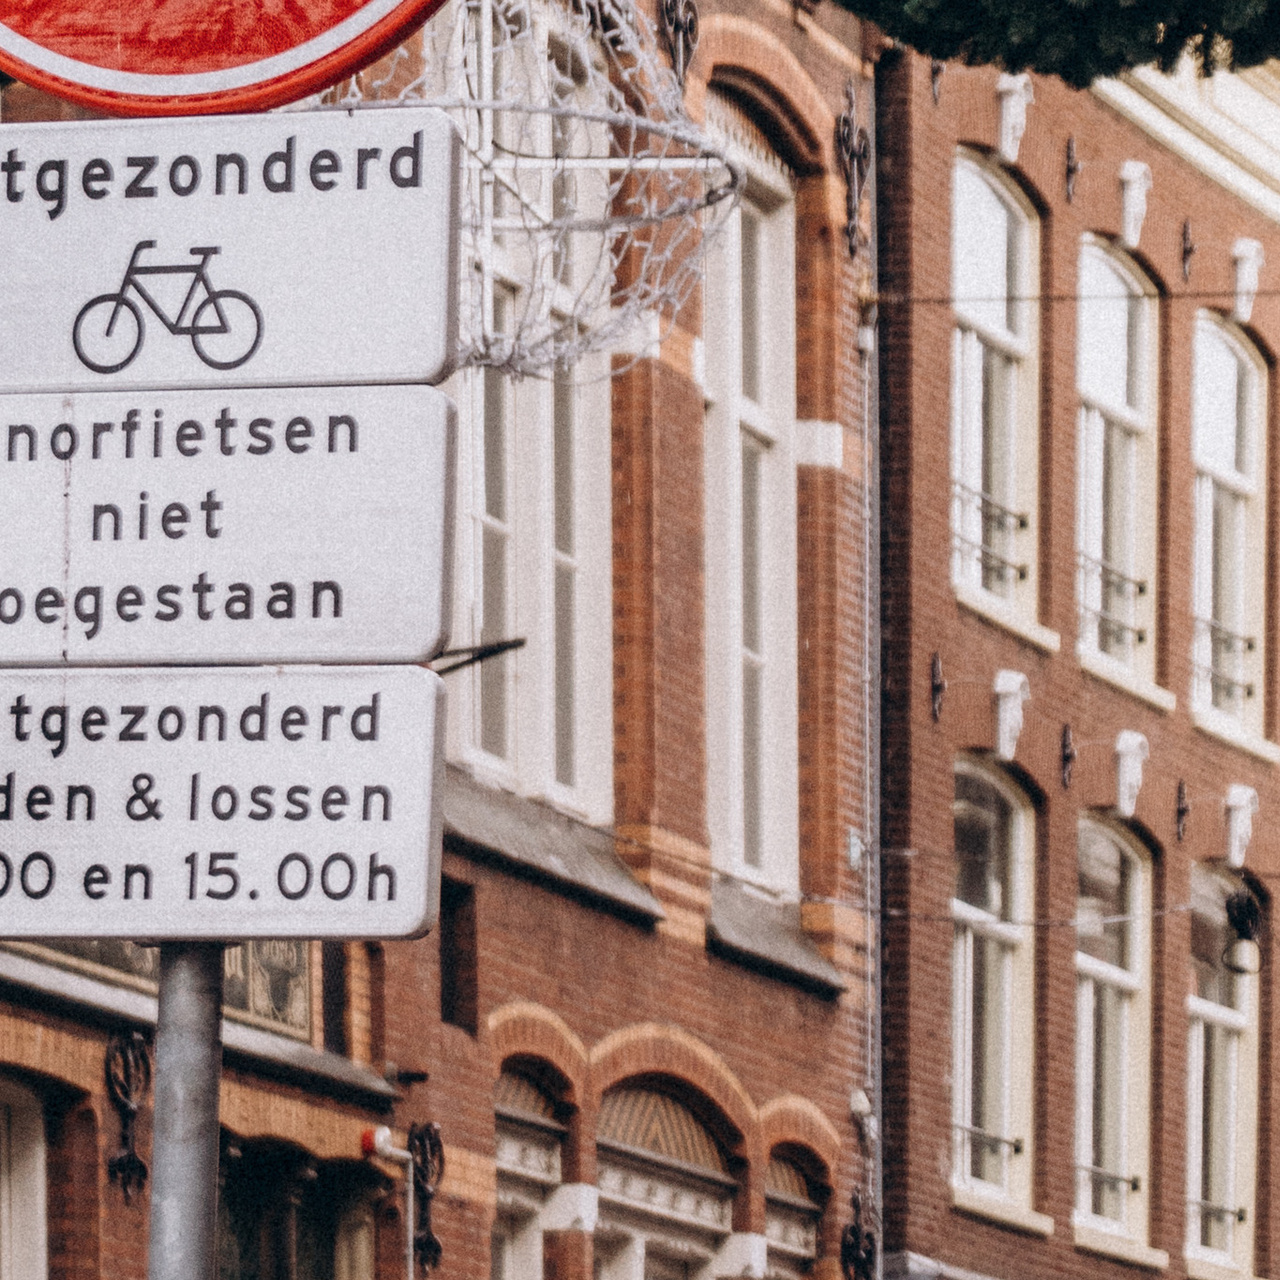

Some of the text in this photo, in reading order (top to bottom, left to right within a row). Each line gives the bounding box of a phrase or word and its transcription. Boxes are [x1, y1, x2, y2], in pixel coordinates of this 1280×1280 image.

[92, 490, 225, 541] niet
[10, 692, 380, 760] tgezonderd
[125, 772, 163, 823] &
[189, 771, 391, 823] lossen
[82, 863, 153, 901] en
[184, 850, 398, 901] 15.00h
